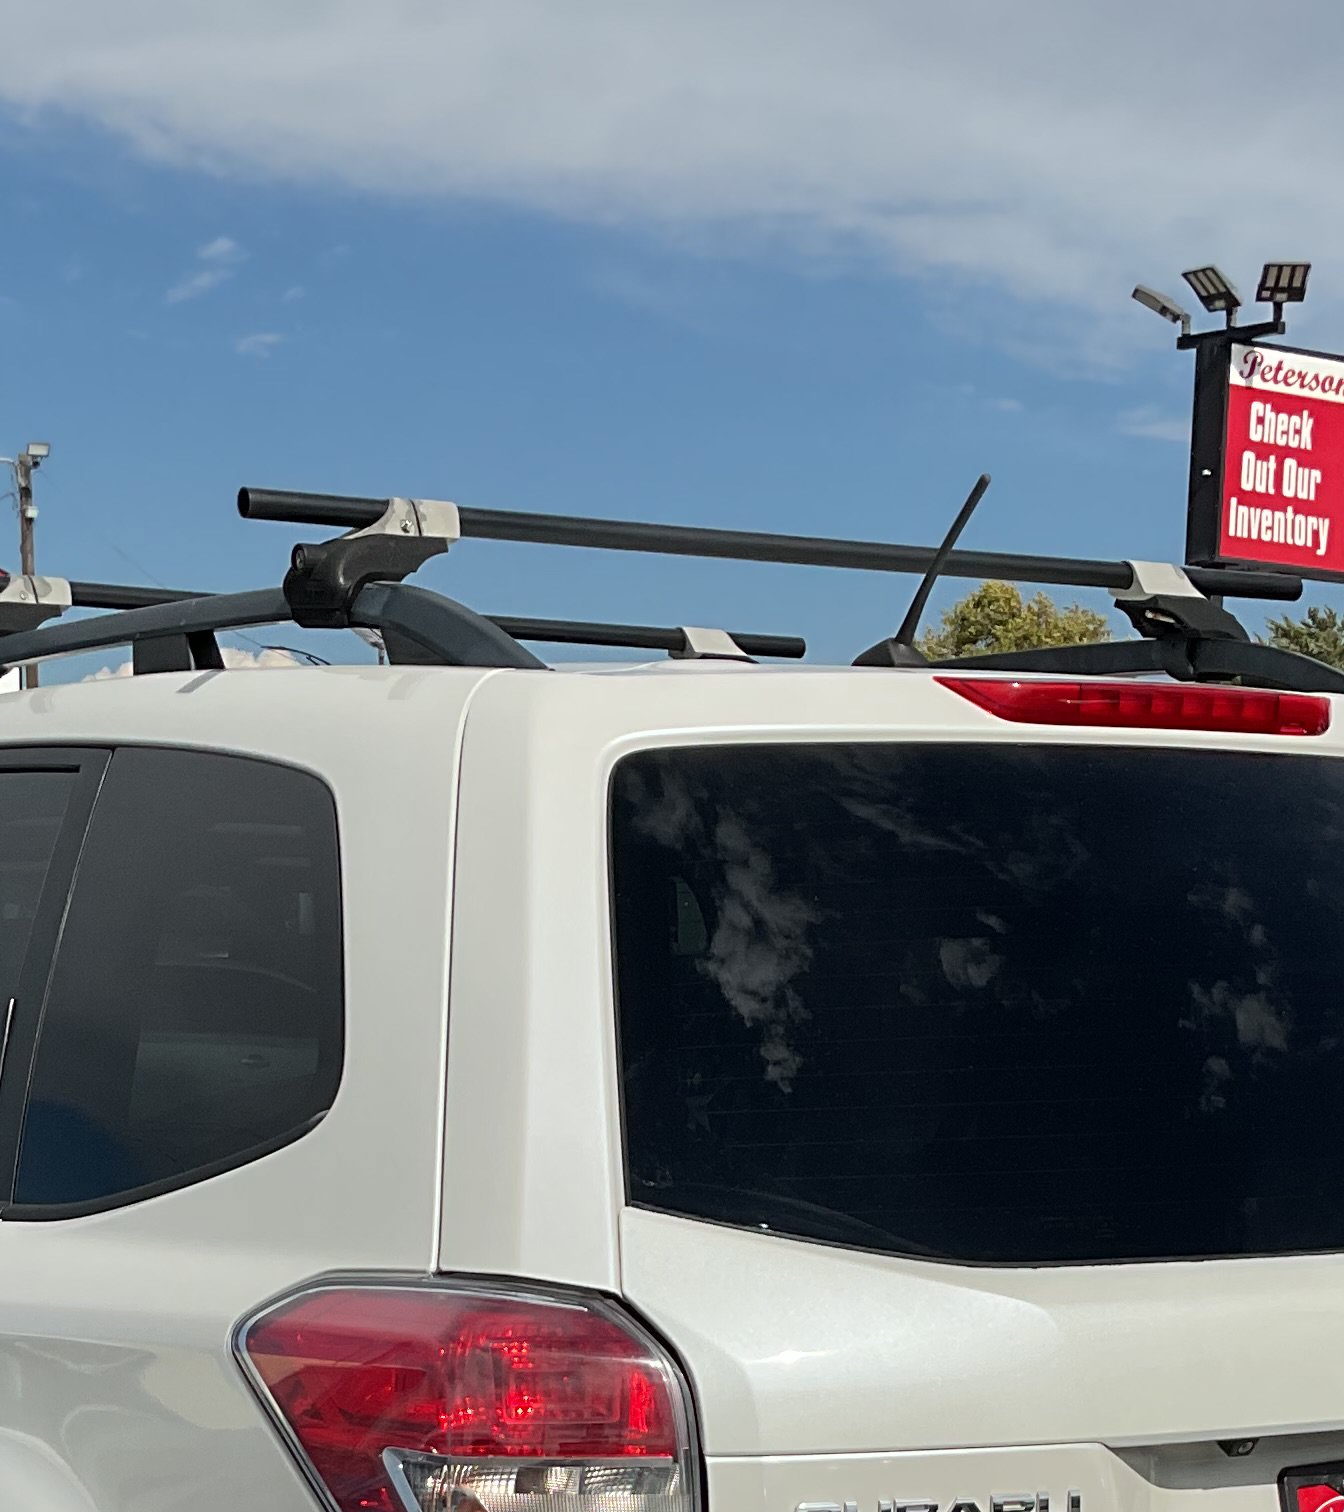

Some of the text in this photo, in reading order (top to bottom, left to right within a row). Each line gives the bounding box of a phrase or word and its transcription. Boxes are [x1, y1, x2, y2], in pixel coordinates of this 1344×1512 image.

[1249, 401, 1313, 450] Check
[1241, 451, 1321, 501] Out Our
[1228, 497, 1330, 556] Inventory
